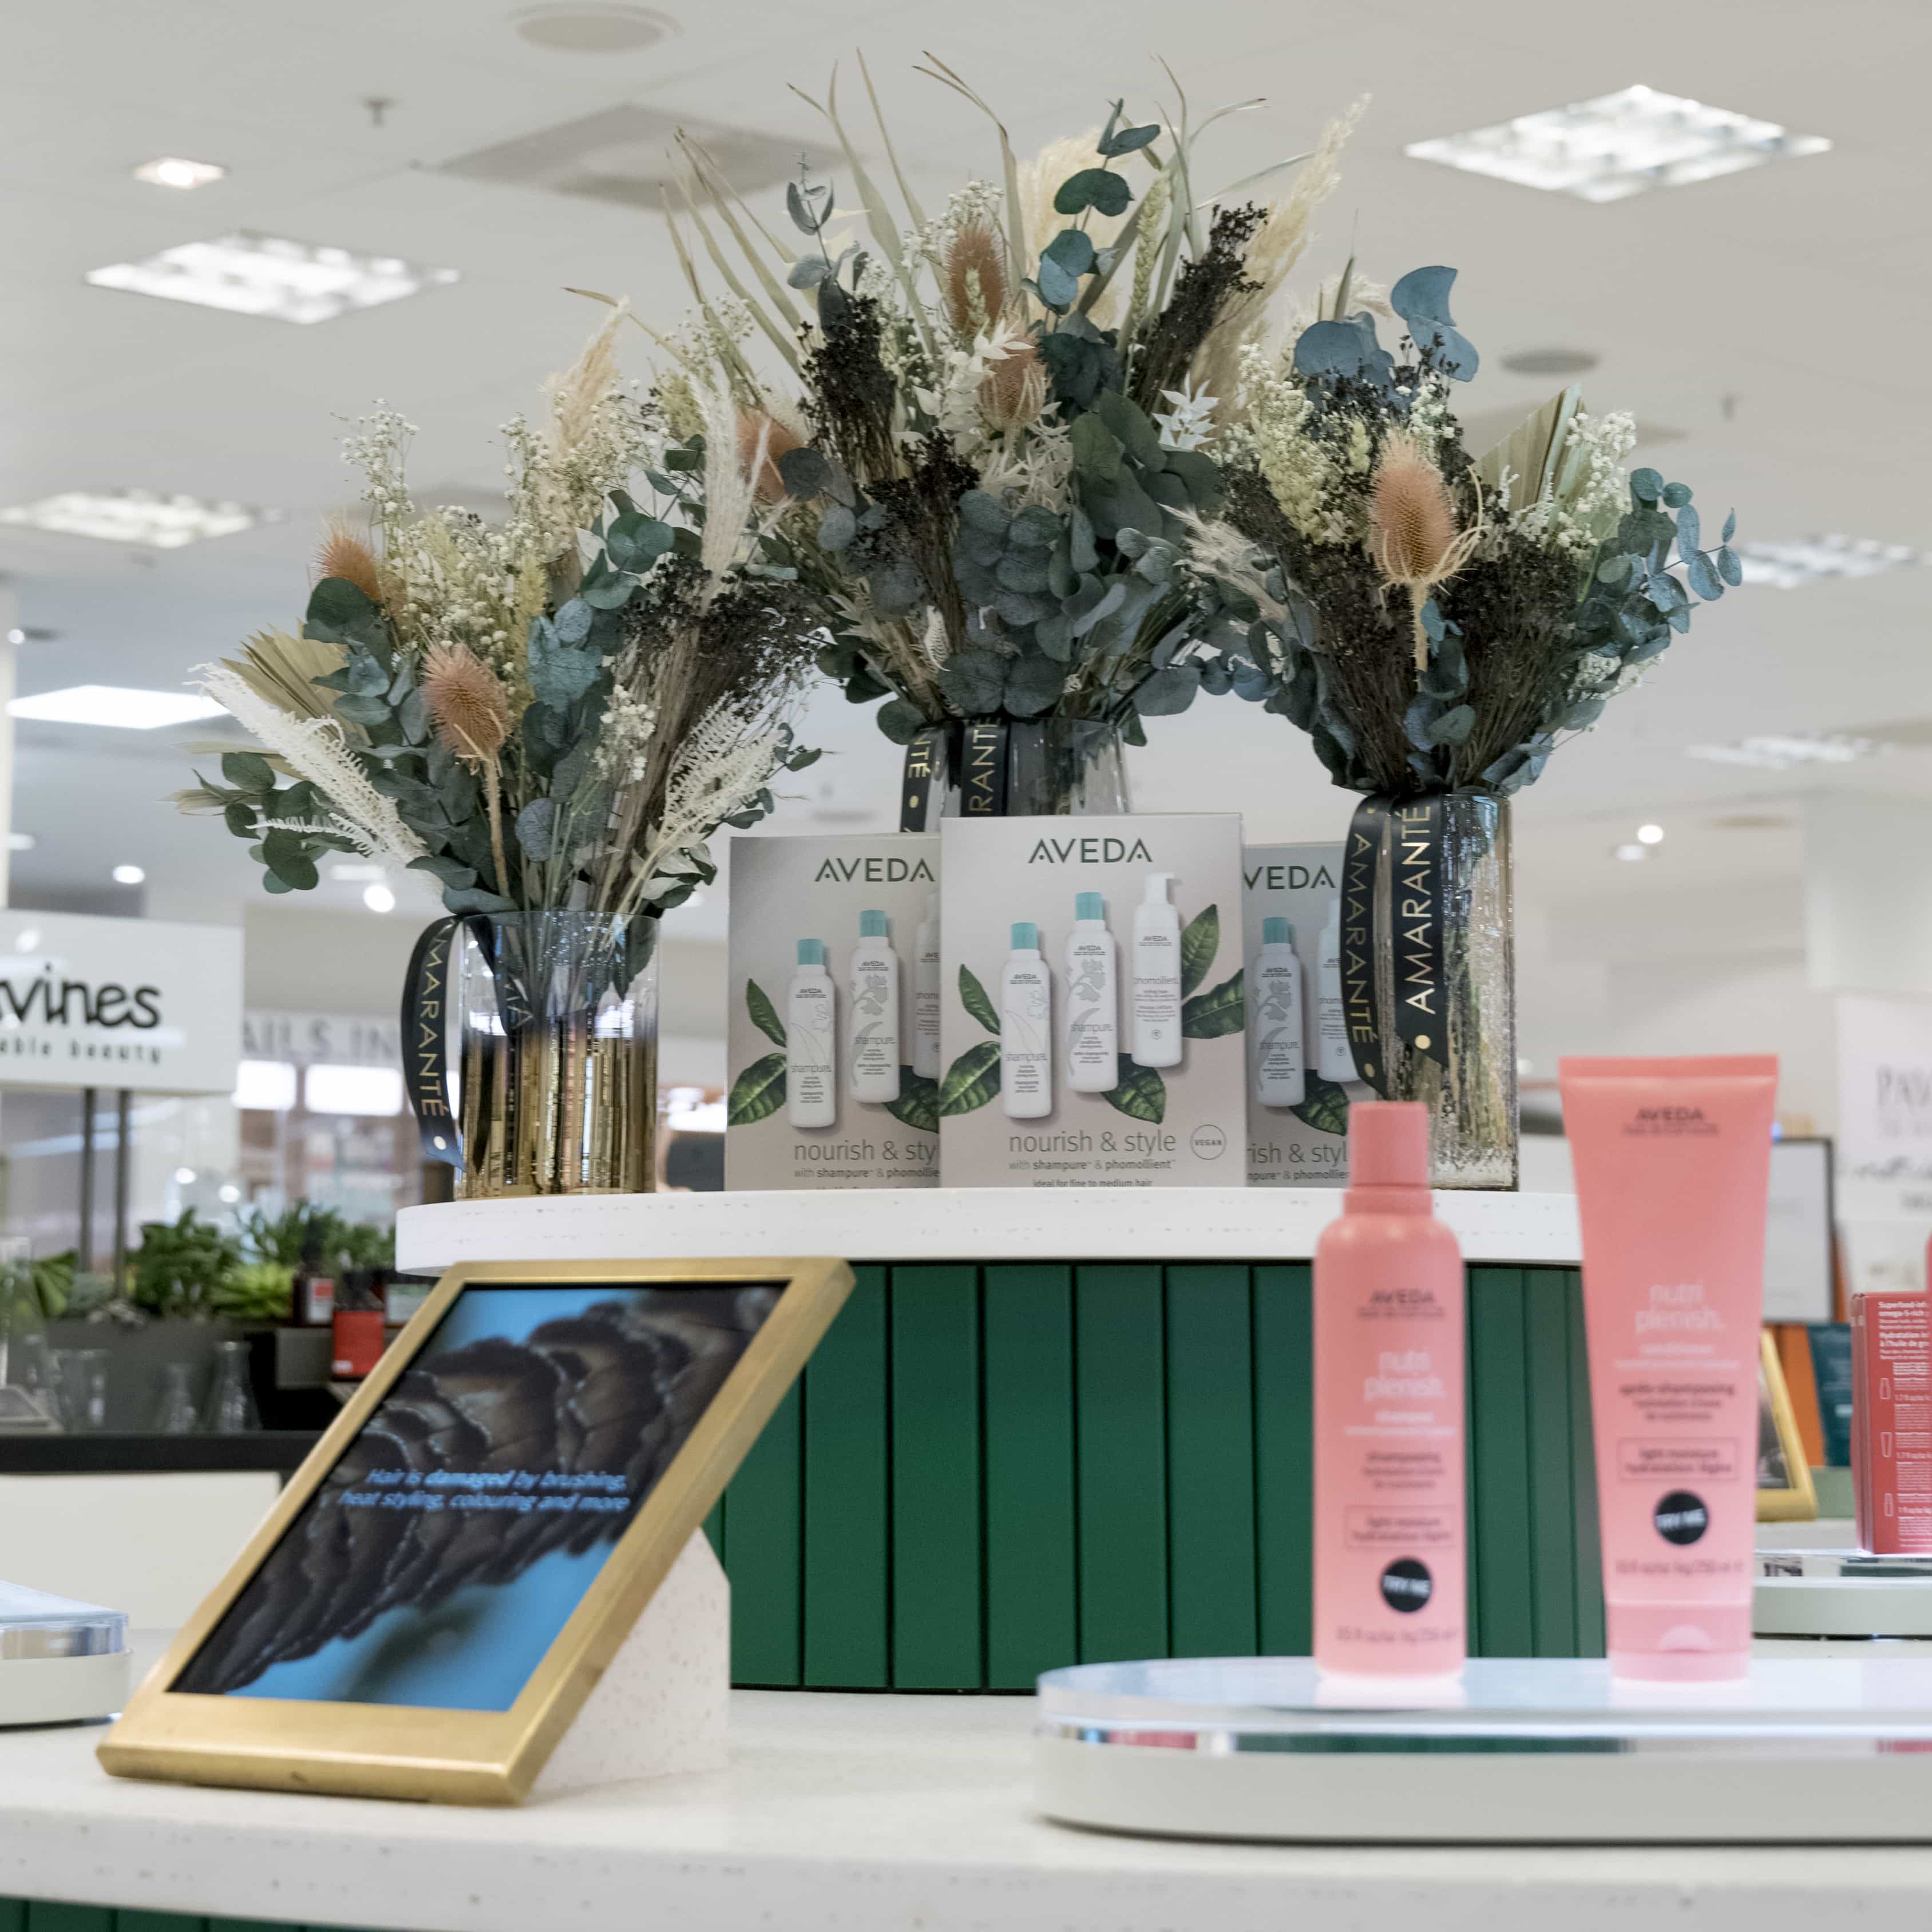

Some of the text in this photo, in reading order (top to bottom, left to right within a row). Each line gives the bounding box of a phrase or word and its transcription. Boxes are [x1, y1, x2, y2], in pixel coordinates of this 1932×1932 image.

[1028, 838, 1153, 864] AVEDA
[814, 858, 936, 882] AVEDA
[70, 1039, 160, 1064] beauty
[1635, 1107, 1704, 1121] AVEDA
[794, 1139, 874, 1161] nourish
[882, 1141, 899, 1160] &
[1009, 1129, 1177, 1157] nourish & style
[1288, 1143, 1305, 1163] &
